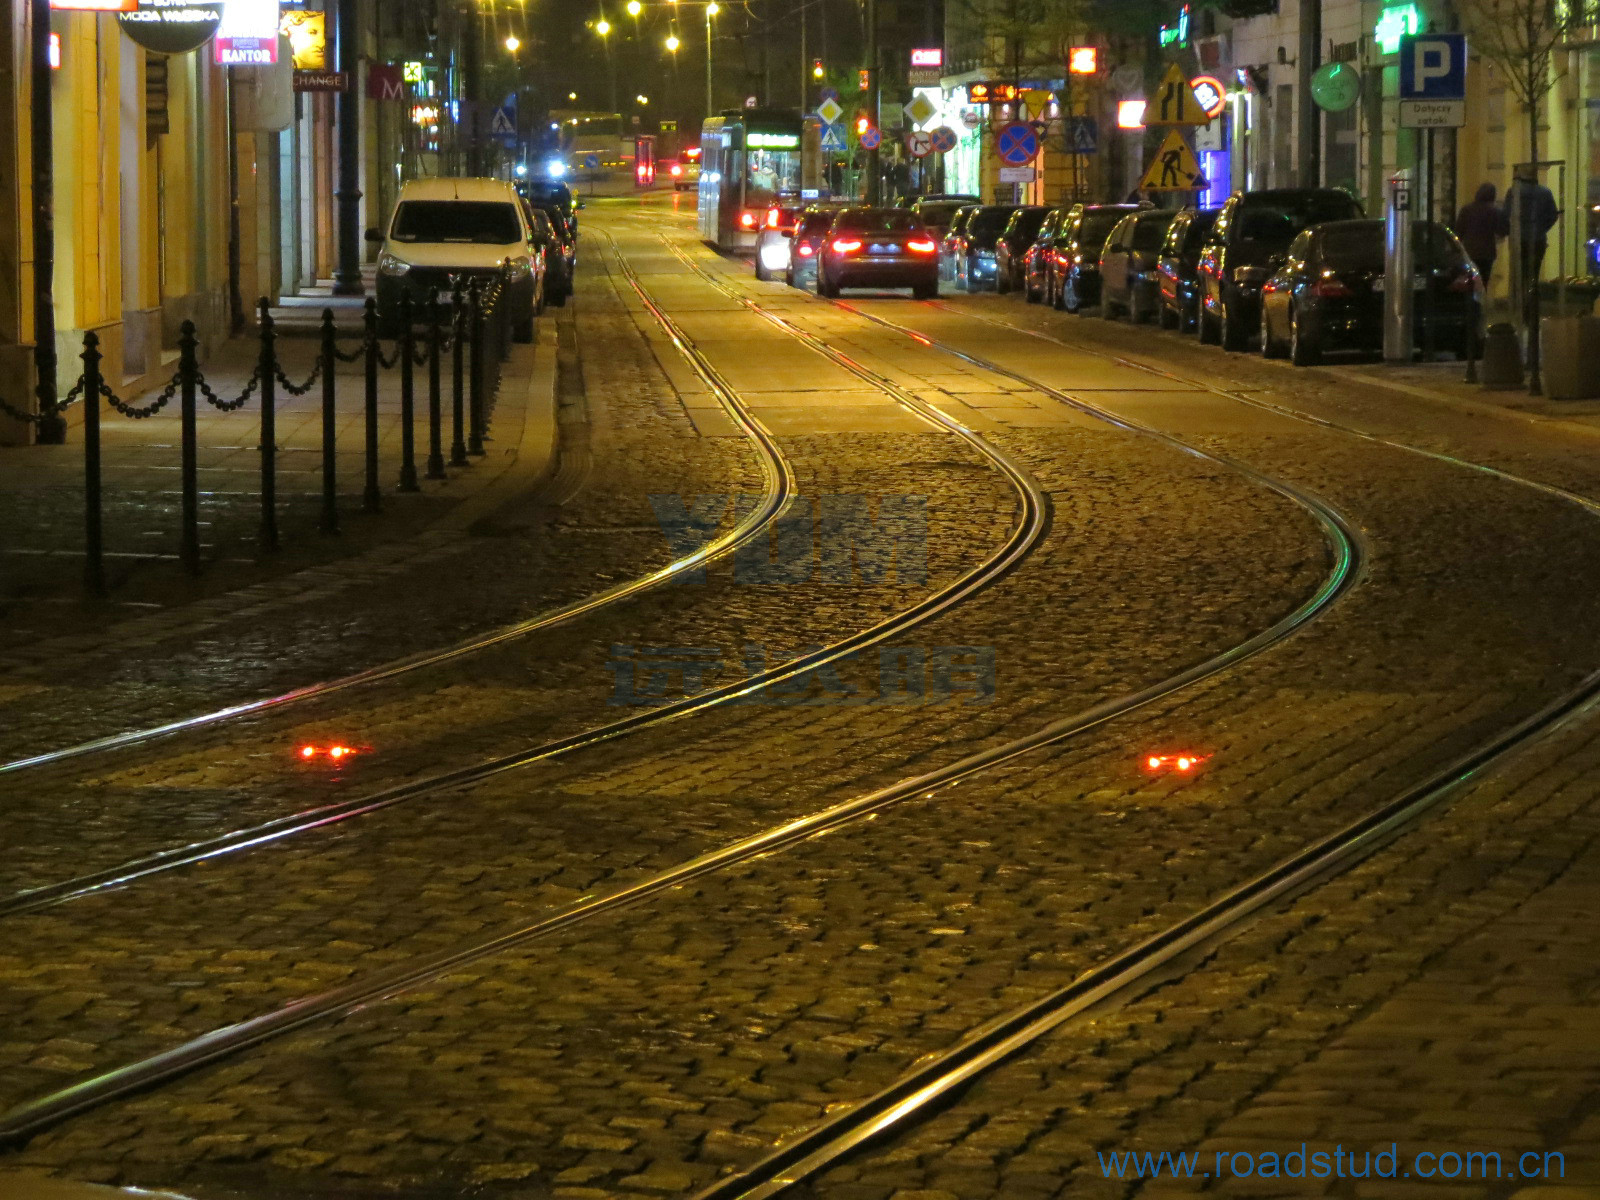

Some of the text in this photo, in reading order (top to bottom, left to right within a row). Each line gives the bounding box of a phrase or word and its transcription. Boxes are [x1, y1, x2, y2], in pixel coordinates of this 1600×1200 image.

[119, 10, 161, 21] MODA
[222, 49, 271, 63] KANTOR
[1414, 41, 1452, 92] P
[1413, 104, 1452, 114] Dotyczy
[1396, 191, 1408, 210] P
